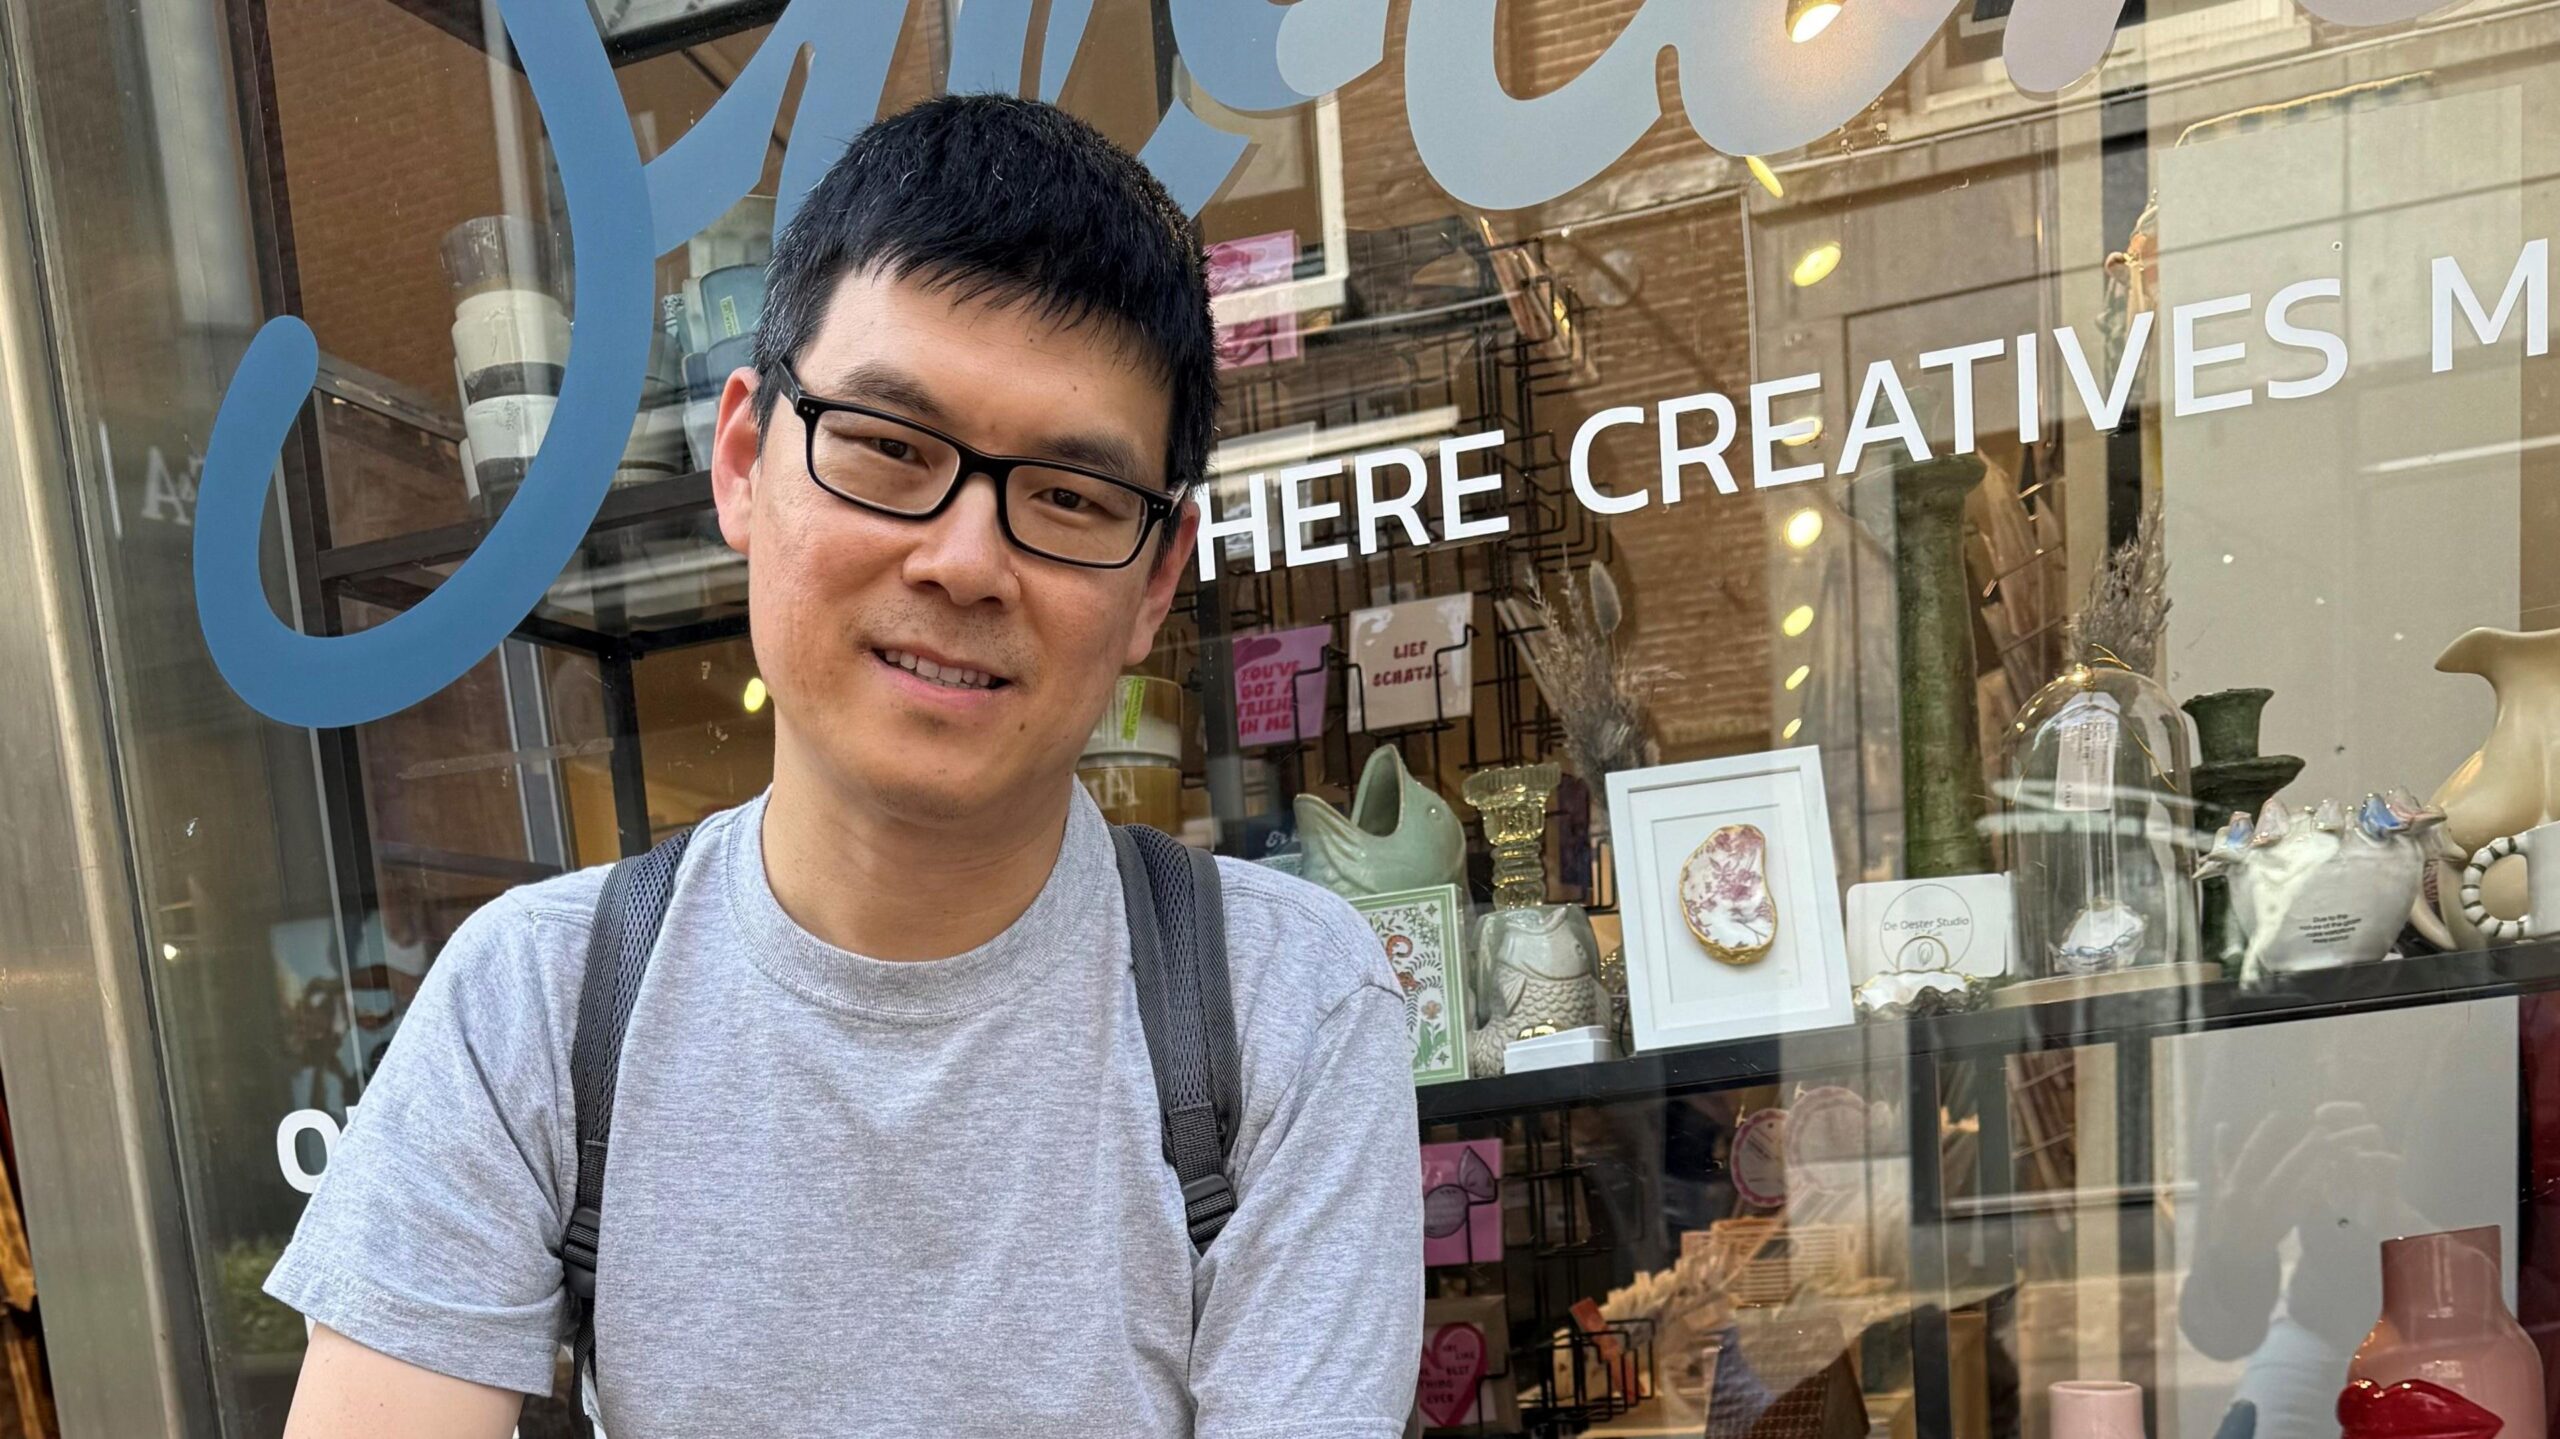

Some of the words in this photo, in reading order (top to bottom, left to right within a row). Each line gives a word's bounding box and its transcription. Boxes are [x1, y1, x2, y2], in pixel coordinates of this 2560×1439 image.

[1195, 430, 1509, 581] HERE
[1571, 278, 2348, 514] CREATIVES
[1393, 640, 1428, 659] LIEF
[1241, 681, 1277, 701] GOT
[1238, 698, 1293, 717] FRIEN
[1240, 718, 1259, 737] IN
[1265, 714, 1291, 733] ME
[1883, 922, 1899, 931] De
[1900, 920, 1934, 930] Oester
[1936, 917, 1970, 928] Studio
